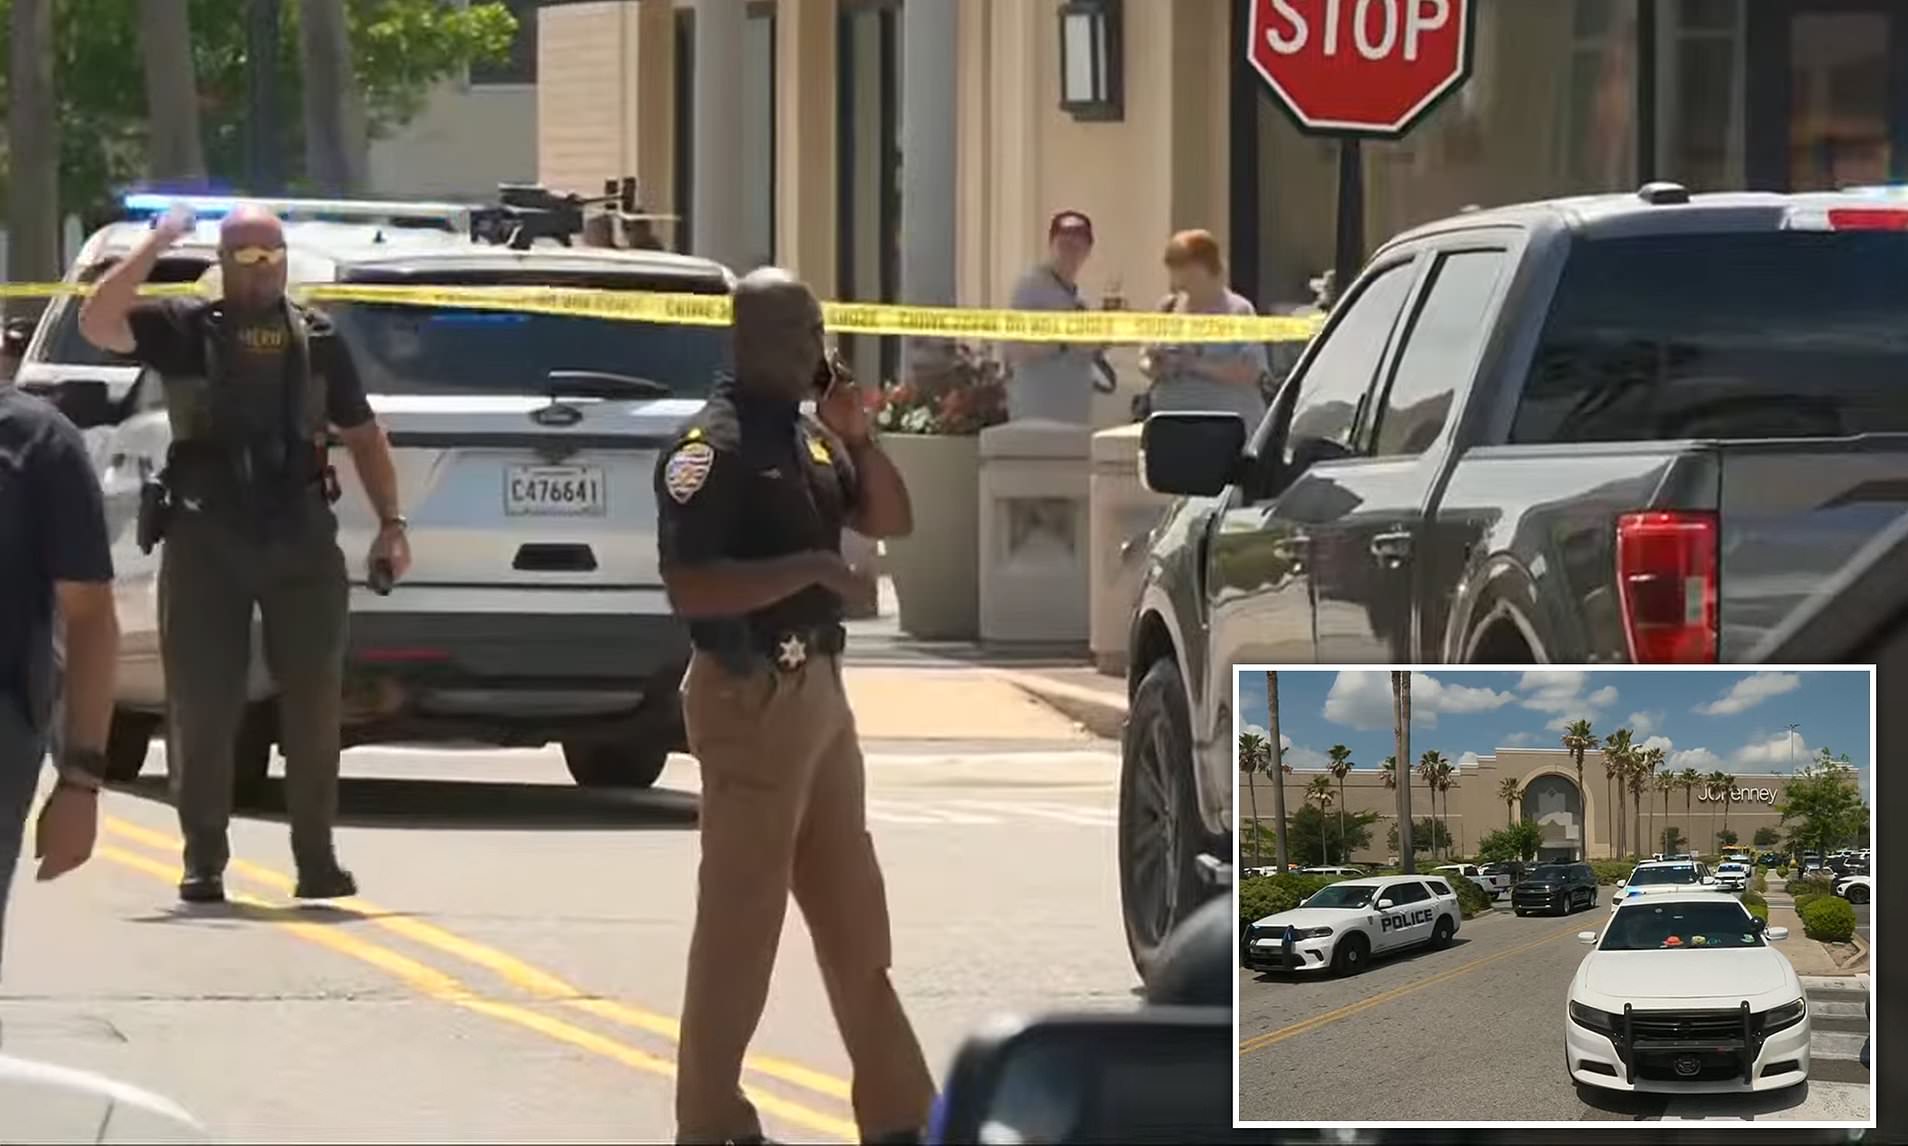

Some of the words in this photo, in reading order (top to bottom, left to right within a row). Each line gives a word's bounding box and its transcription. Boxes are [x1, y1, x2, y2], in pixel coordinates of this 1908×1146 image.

[1266, 0, 1450, 60] STOP
[511, 479, 597, 503] C476641
[1380, 908, 1434, 933] POLICE
